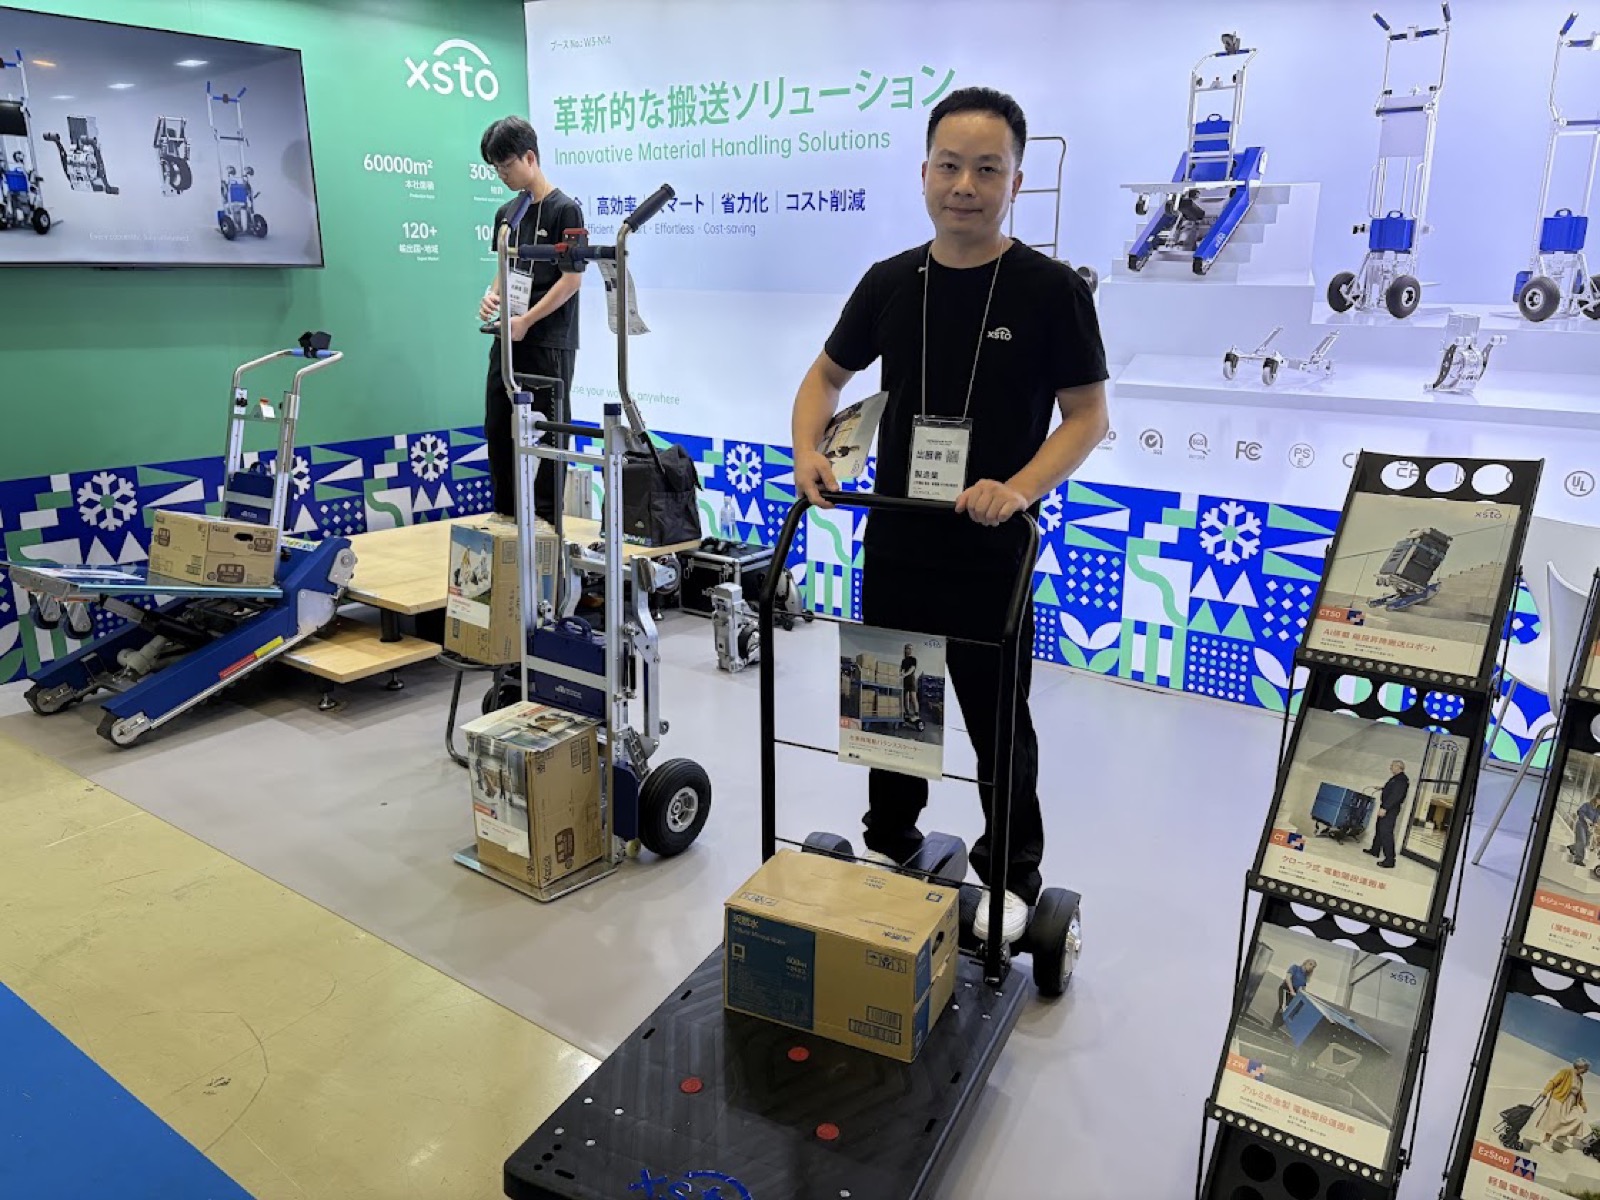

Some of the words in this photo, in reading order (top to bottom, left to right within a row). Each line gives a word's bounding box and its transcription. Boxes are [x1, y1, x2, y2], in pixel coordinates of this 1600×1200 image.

[404, 54, 499, 101] xsto
[553, 65, 956, 136] 革新的な搬送ソリューション
[555, 144, 633, 166] Innovative
[638, 138, 706, 161] Material
[711, 133, 792, 159] Handling
[798, 129, 891, 152] Solutions
[597, 195, 637, 216] 高効率
[658, 193, 705, 214] マート
[721, 191, 769, 214] 省力化
[785, 187, 867, 212] コスト削減
[402, 221, 438, 239] 120+
[584, 223, 615, 234] fficient
[655, 223, 695, 235] Effortless
[703, 222, 756, 237] Cost-saving
[987, 328, 1012, 342] xsto
[1475, 510, 1503, 520] xsto
[1390, 972, 1417, 986] xsto
